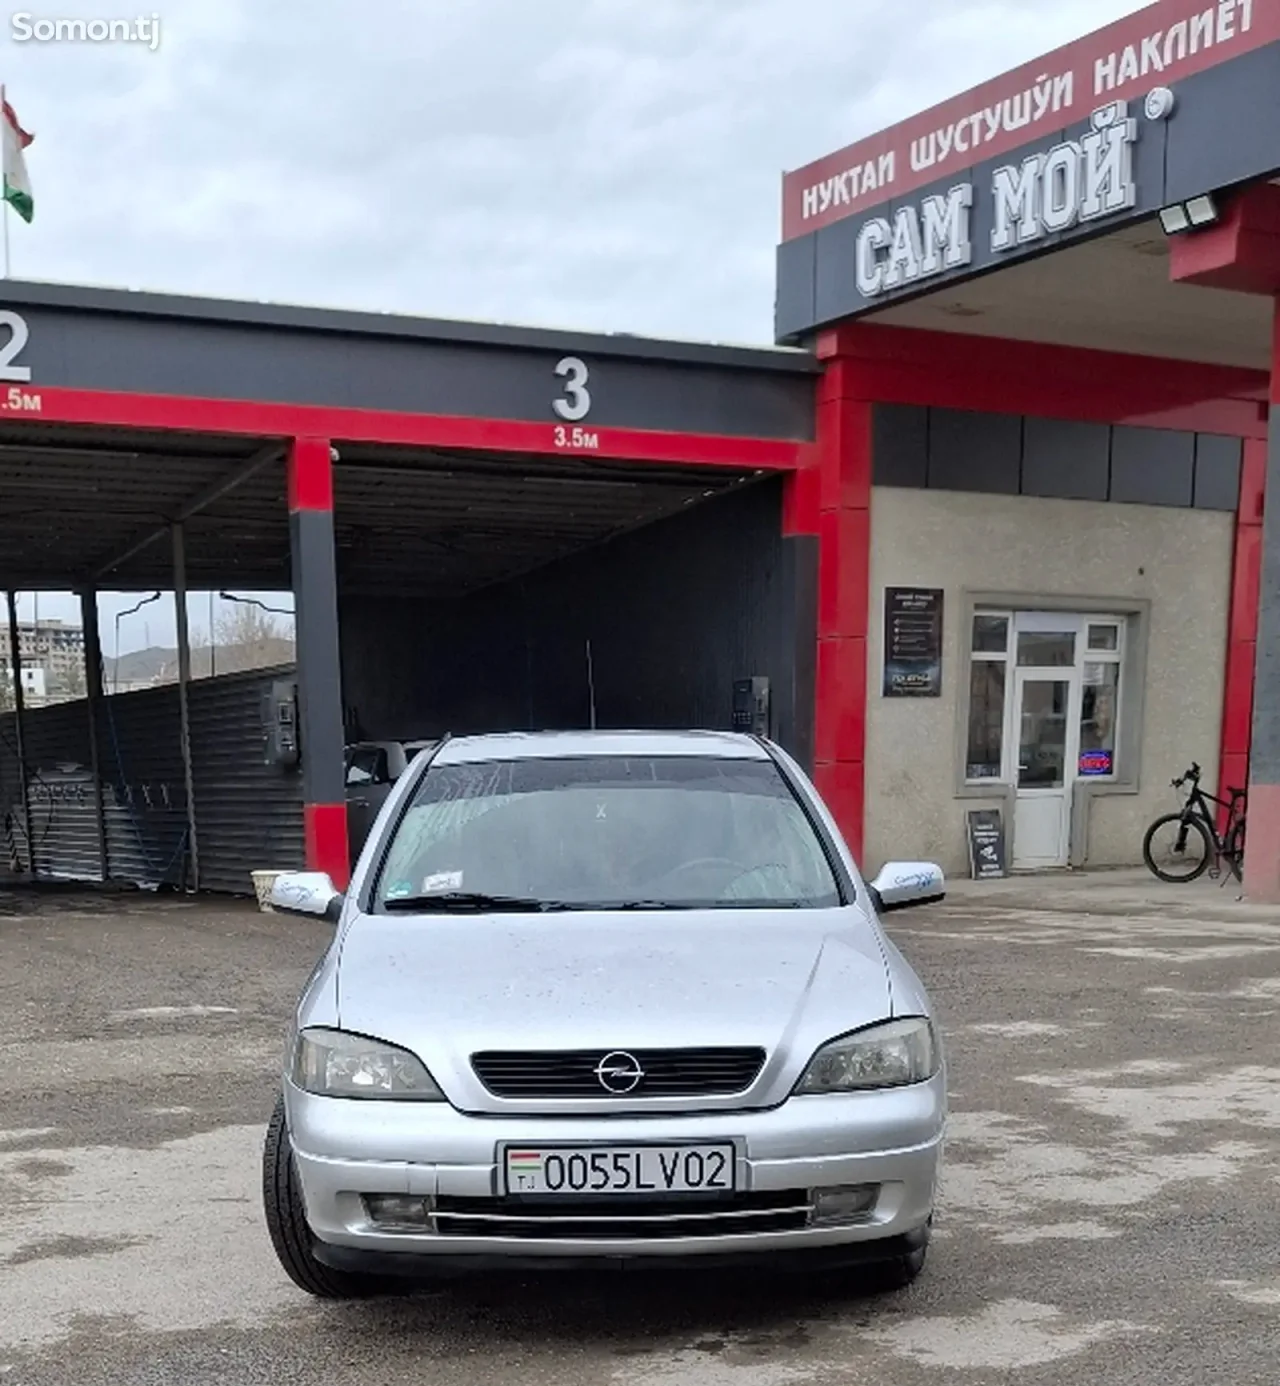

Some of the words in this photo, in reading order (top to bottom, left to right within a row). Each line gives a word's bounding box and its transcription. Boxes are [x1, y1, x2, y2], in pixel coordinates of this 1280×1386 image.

[855, 183, 973, 297] САМ
[990, 99, 1137, 253] МОЙ
[0, 309, 31, 381] 2
[1, 387, 41, 412] .5м
[552, 356, 591, 421] 3
[544, 1150, 727, 1190] 0055LV02
